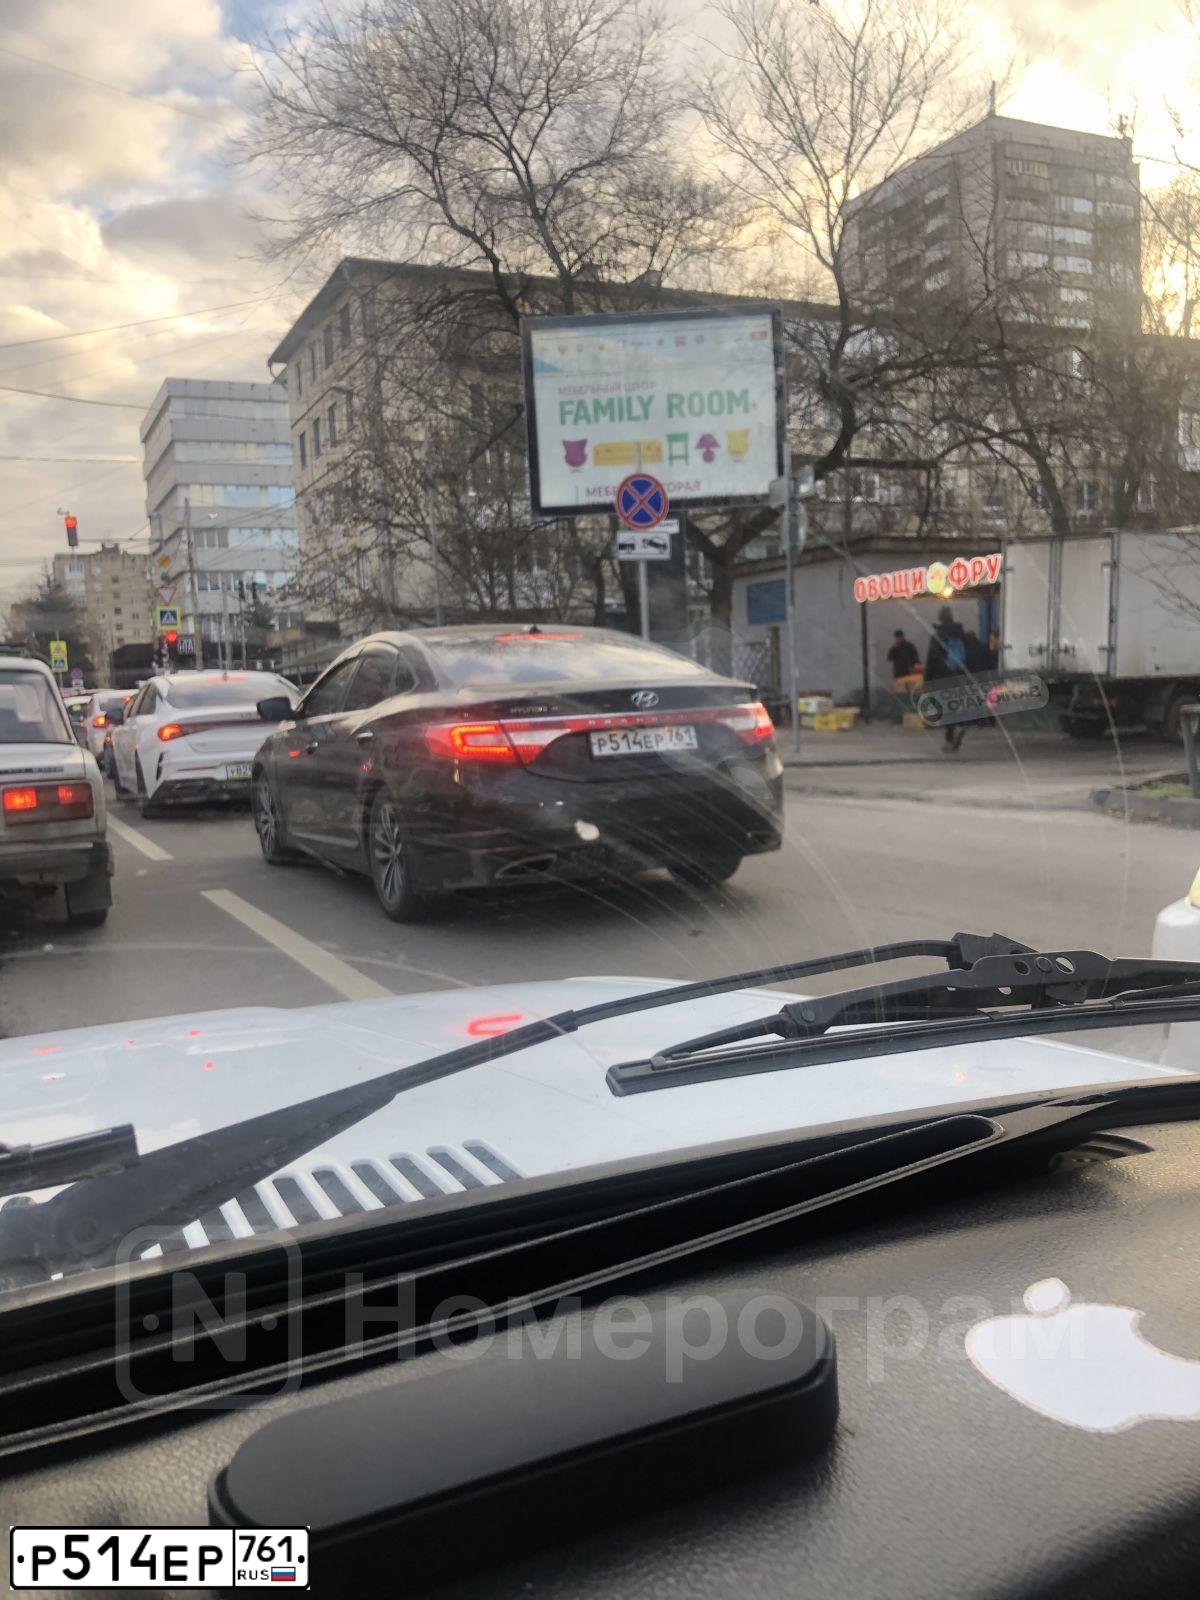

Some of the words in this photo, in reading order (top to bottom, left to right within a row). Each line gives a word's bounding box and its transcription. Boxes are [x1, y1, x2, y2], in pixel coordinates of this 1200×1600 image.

[560, 395, 655, 426] FAMILY
[666, 388, 750, 418] ROOM
[855, 567, 925, 601] ОВОЩИ
[949, 553, 1002, 589] ФРУ
[597, 730, 664, 752] Р514ЕР
[666, 726, 694, 743] 761
